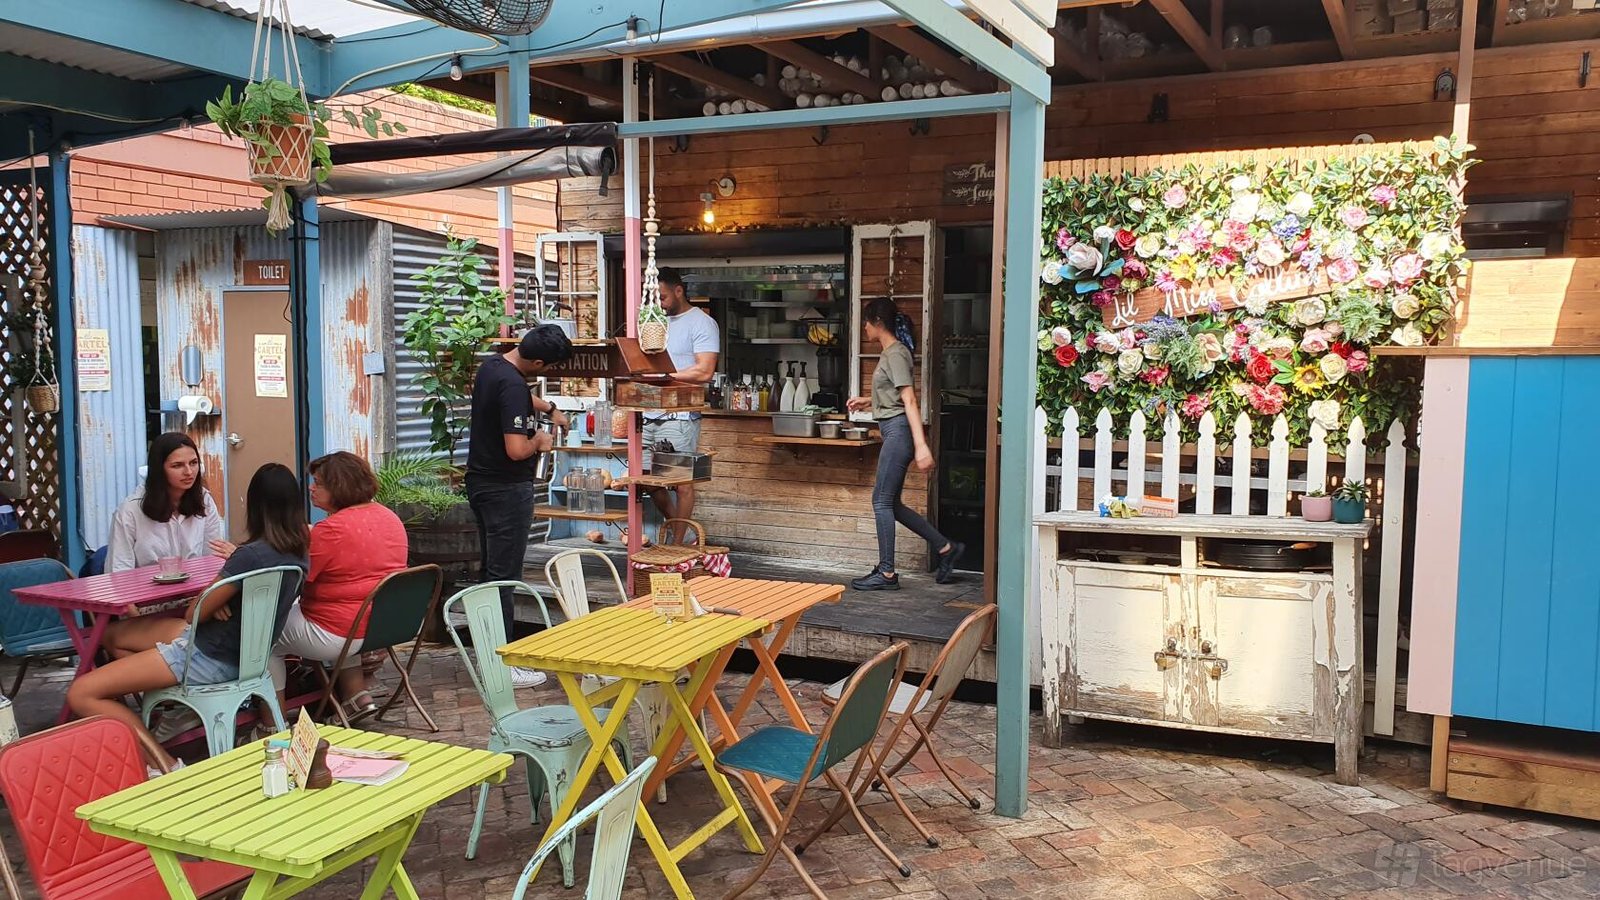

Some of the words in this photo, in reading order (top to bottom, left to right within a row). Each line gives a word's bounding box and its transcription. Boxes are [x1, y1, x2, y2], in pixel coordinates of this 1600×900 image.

[258, 265, 285, 279] TOILET
[1112, 293, 1139, 326] Lil
[1163, 286, 1217, 318] Miss
[79, 340, 108, 349] ARTEL
